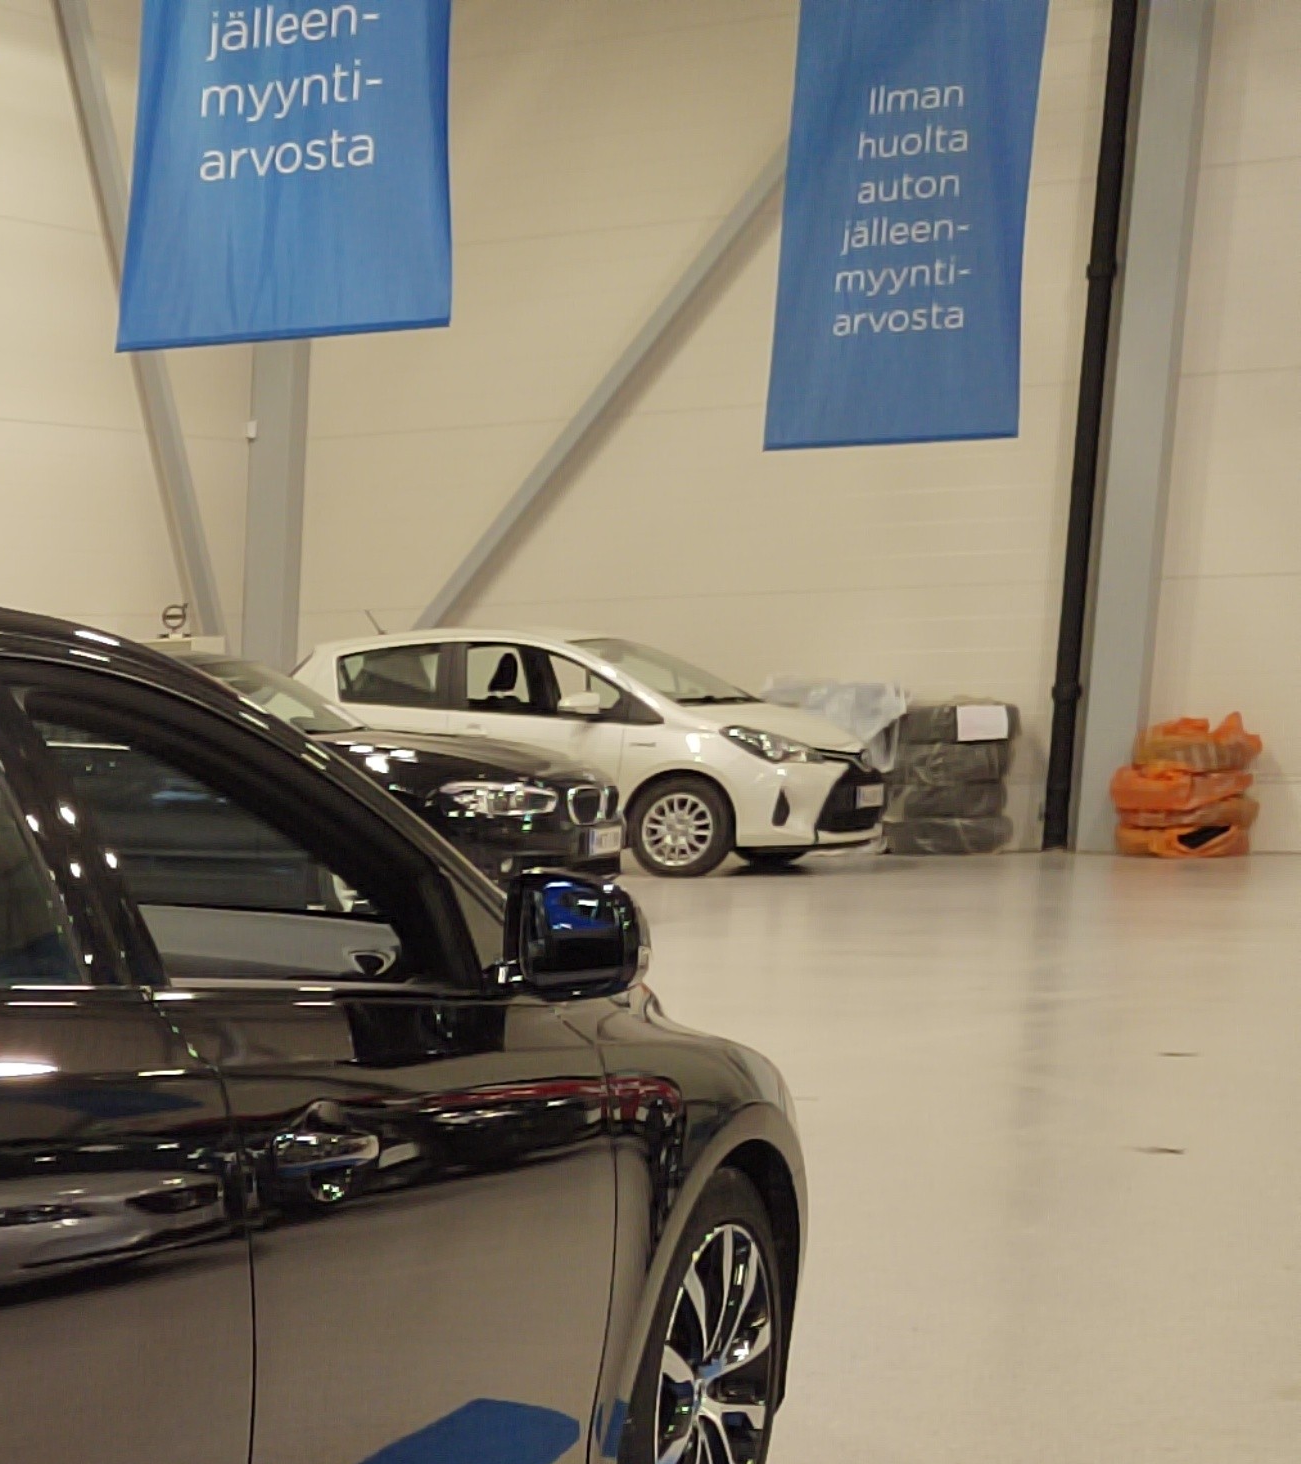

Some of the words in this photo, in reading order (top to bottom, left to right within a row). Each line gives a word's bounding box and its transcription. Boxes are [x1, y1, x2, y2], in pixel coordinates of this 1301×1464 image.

[205, 4, 381, 62] jälleen-
[200, 58, 384, 122] myynti-
[868, 84, 965, 116] Ilman
[199, 128, 375, 182] arvosta
[857, 123, 969, 161] huolta
[856, 172, 961, 205] auton
[839, 215, 972, 257] jälleen-
[834, 255, 972, 297] myynti-
[832, 301, 965, 337] arvosta
